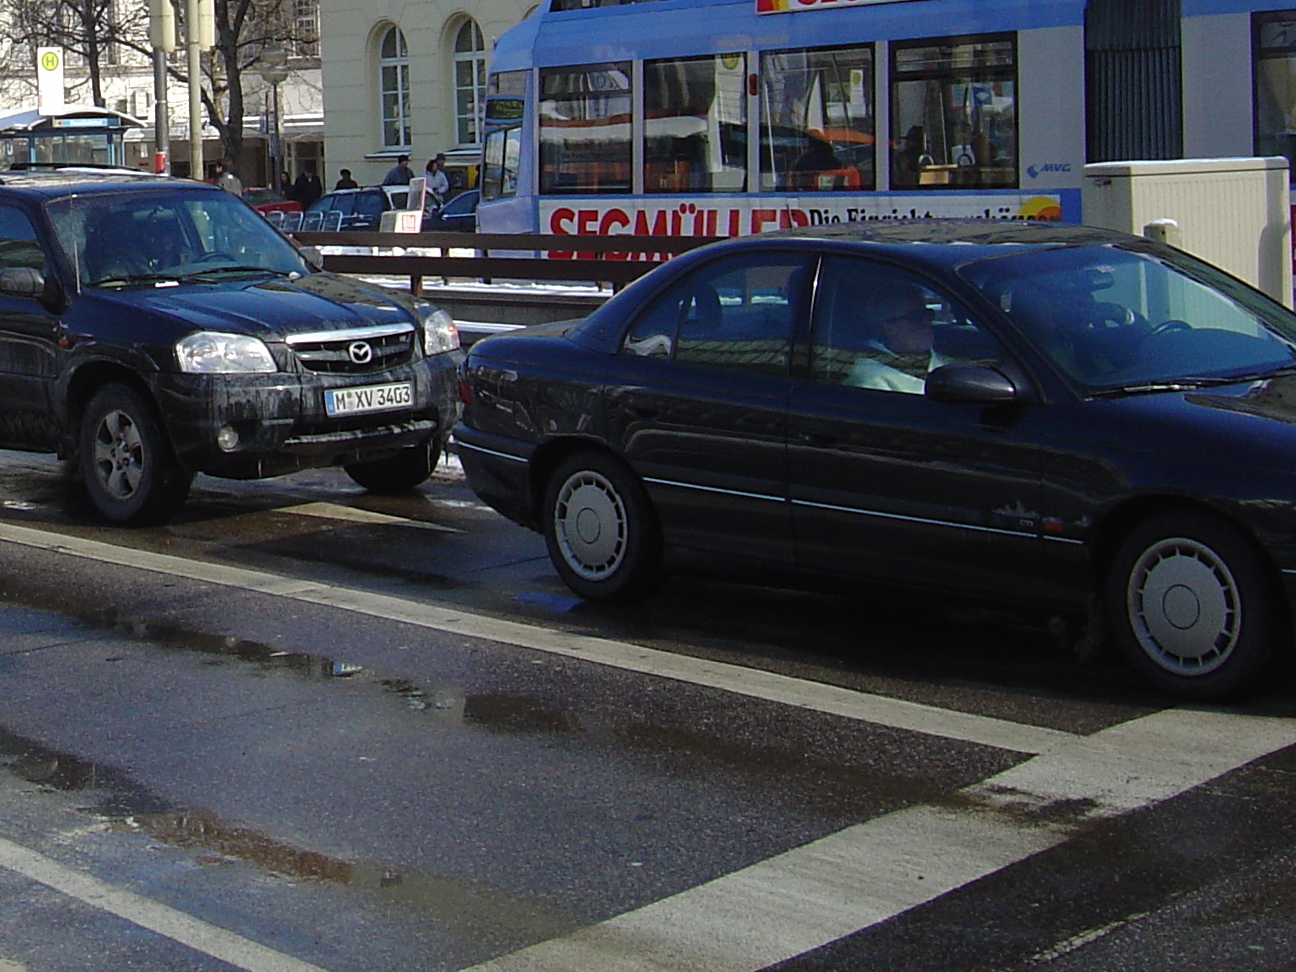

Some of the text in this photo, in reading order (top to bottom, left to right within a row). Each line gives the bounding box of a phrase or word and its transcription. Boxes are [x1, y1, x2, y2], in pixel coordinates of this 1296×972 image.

[335, 385, 410, 411] M XV 3403
